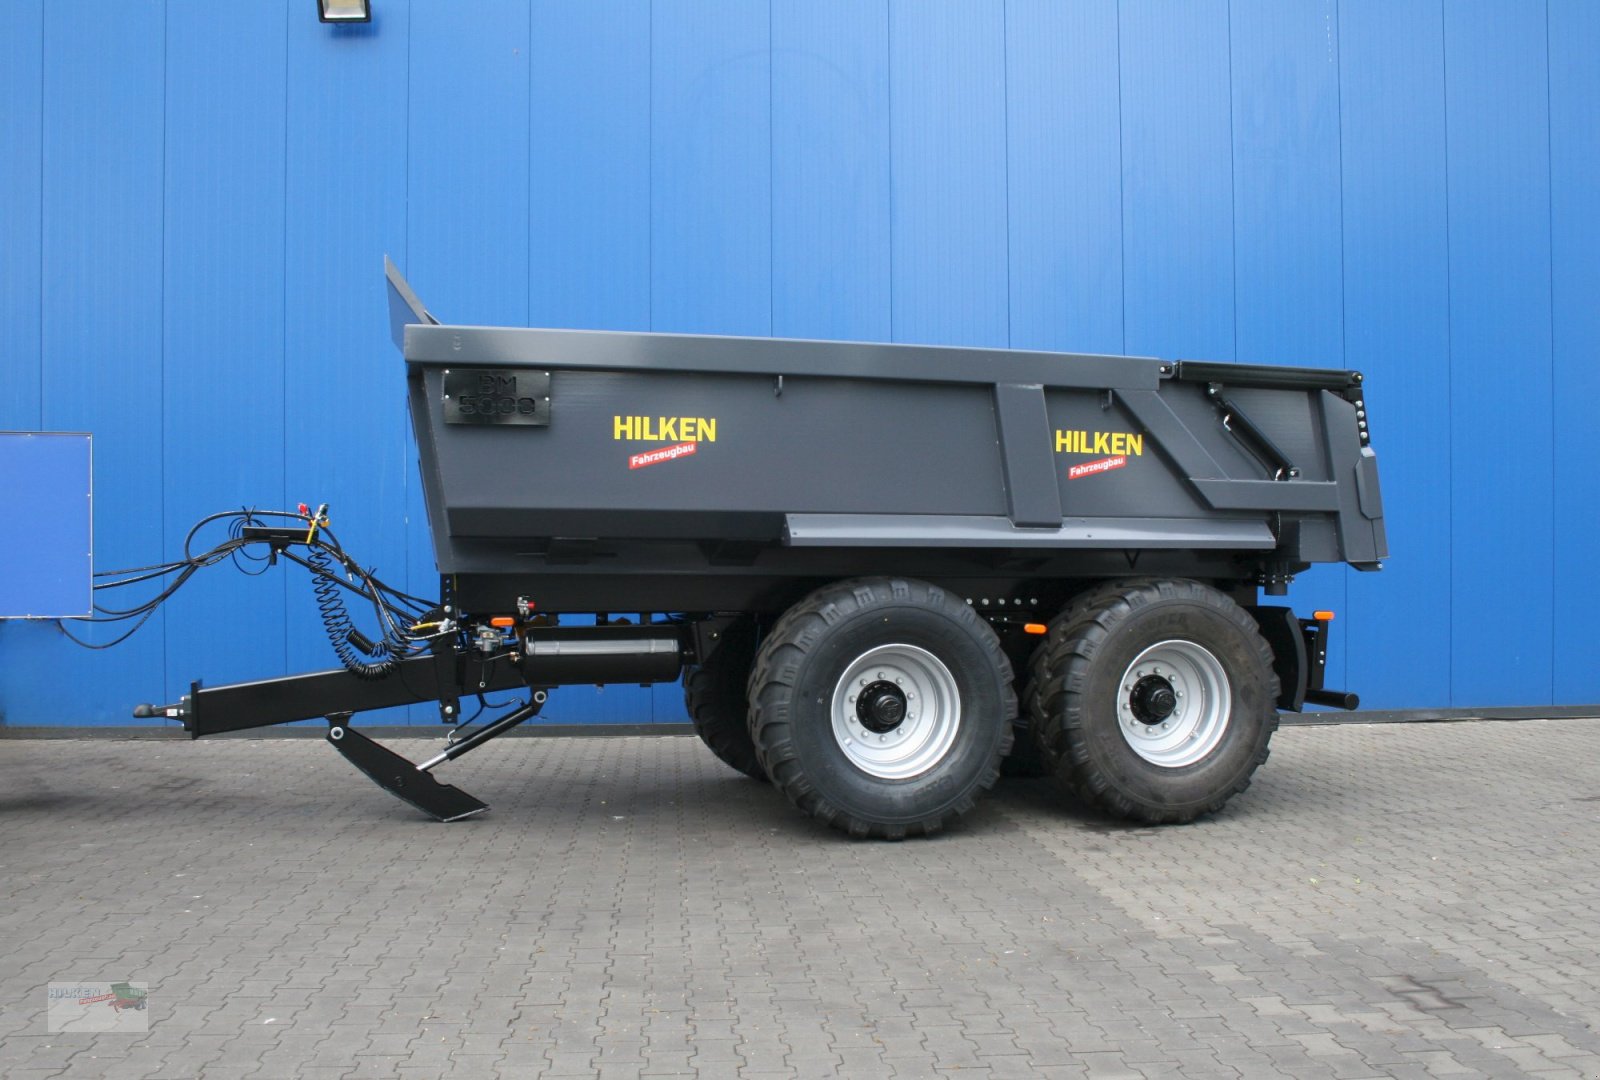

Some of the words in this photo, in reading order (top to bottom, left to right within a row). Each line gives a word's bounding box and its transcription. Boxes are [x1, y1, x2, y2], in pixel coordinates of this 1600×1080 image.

[614, 416, 716, 442] HILKEN
[632, 444, 695, 466] Fahrzeugbau
[1056, 430, 1142, 456] HILKEN
[1070, 457, 1124, 476] Fahrzeugbau
